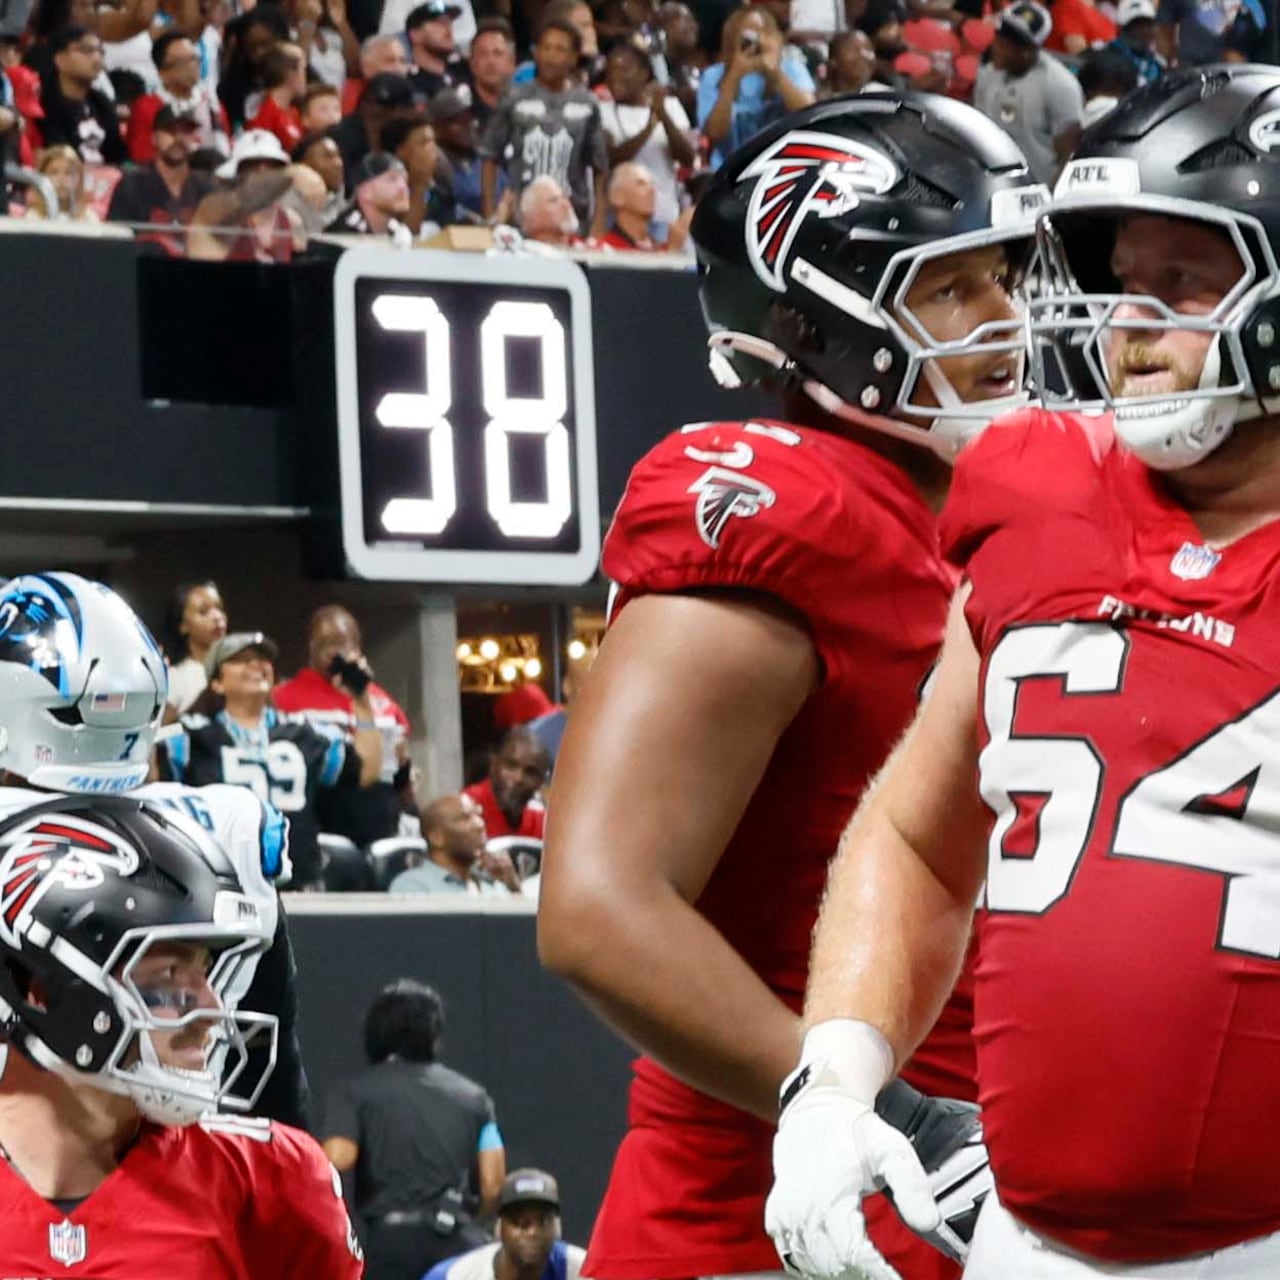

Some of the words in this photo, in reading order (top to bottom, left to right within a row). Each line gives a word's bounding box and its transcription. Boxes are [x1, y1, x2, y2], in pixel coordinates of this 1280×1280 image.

[1070, 165, 1111, 189] ATL
[372, 295, 571, 537] 38
[119, 731, 140, 761] 7
[220, 735, 308, 812] 59
[978, 621, 1280, 962] 64
